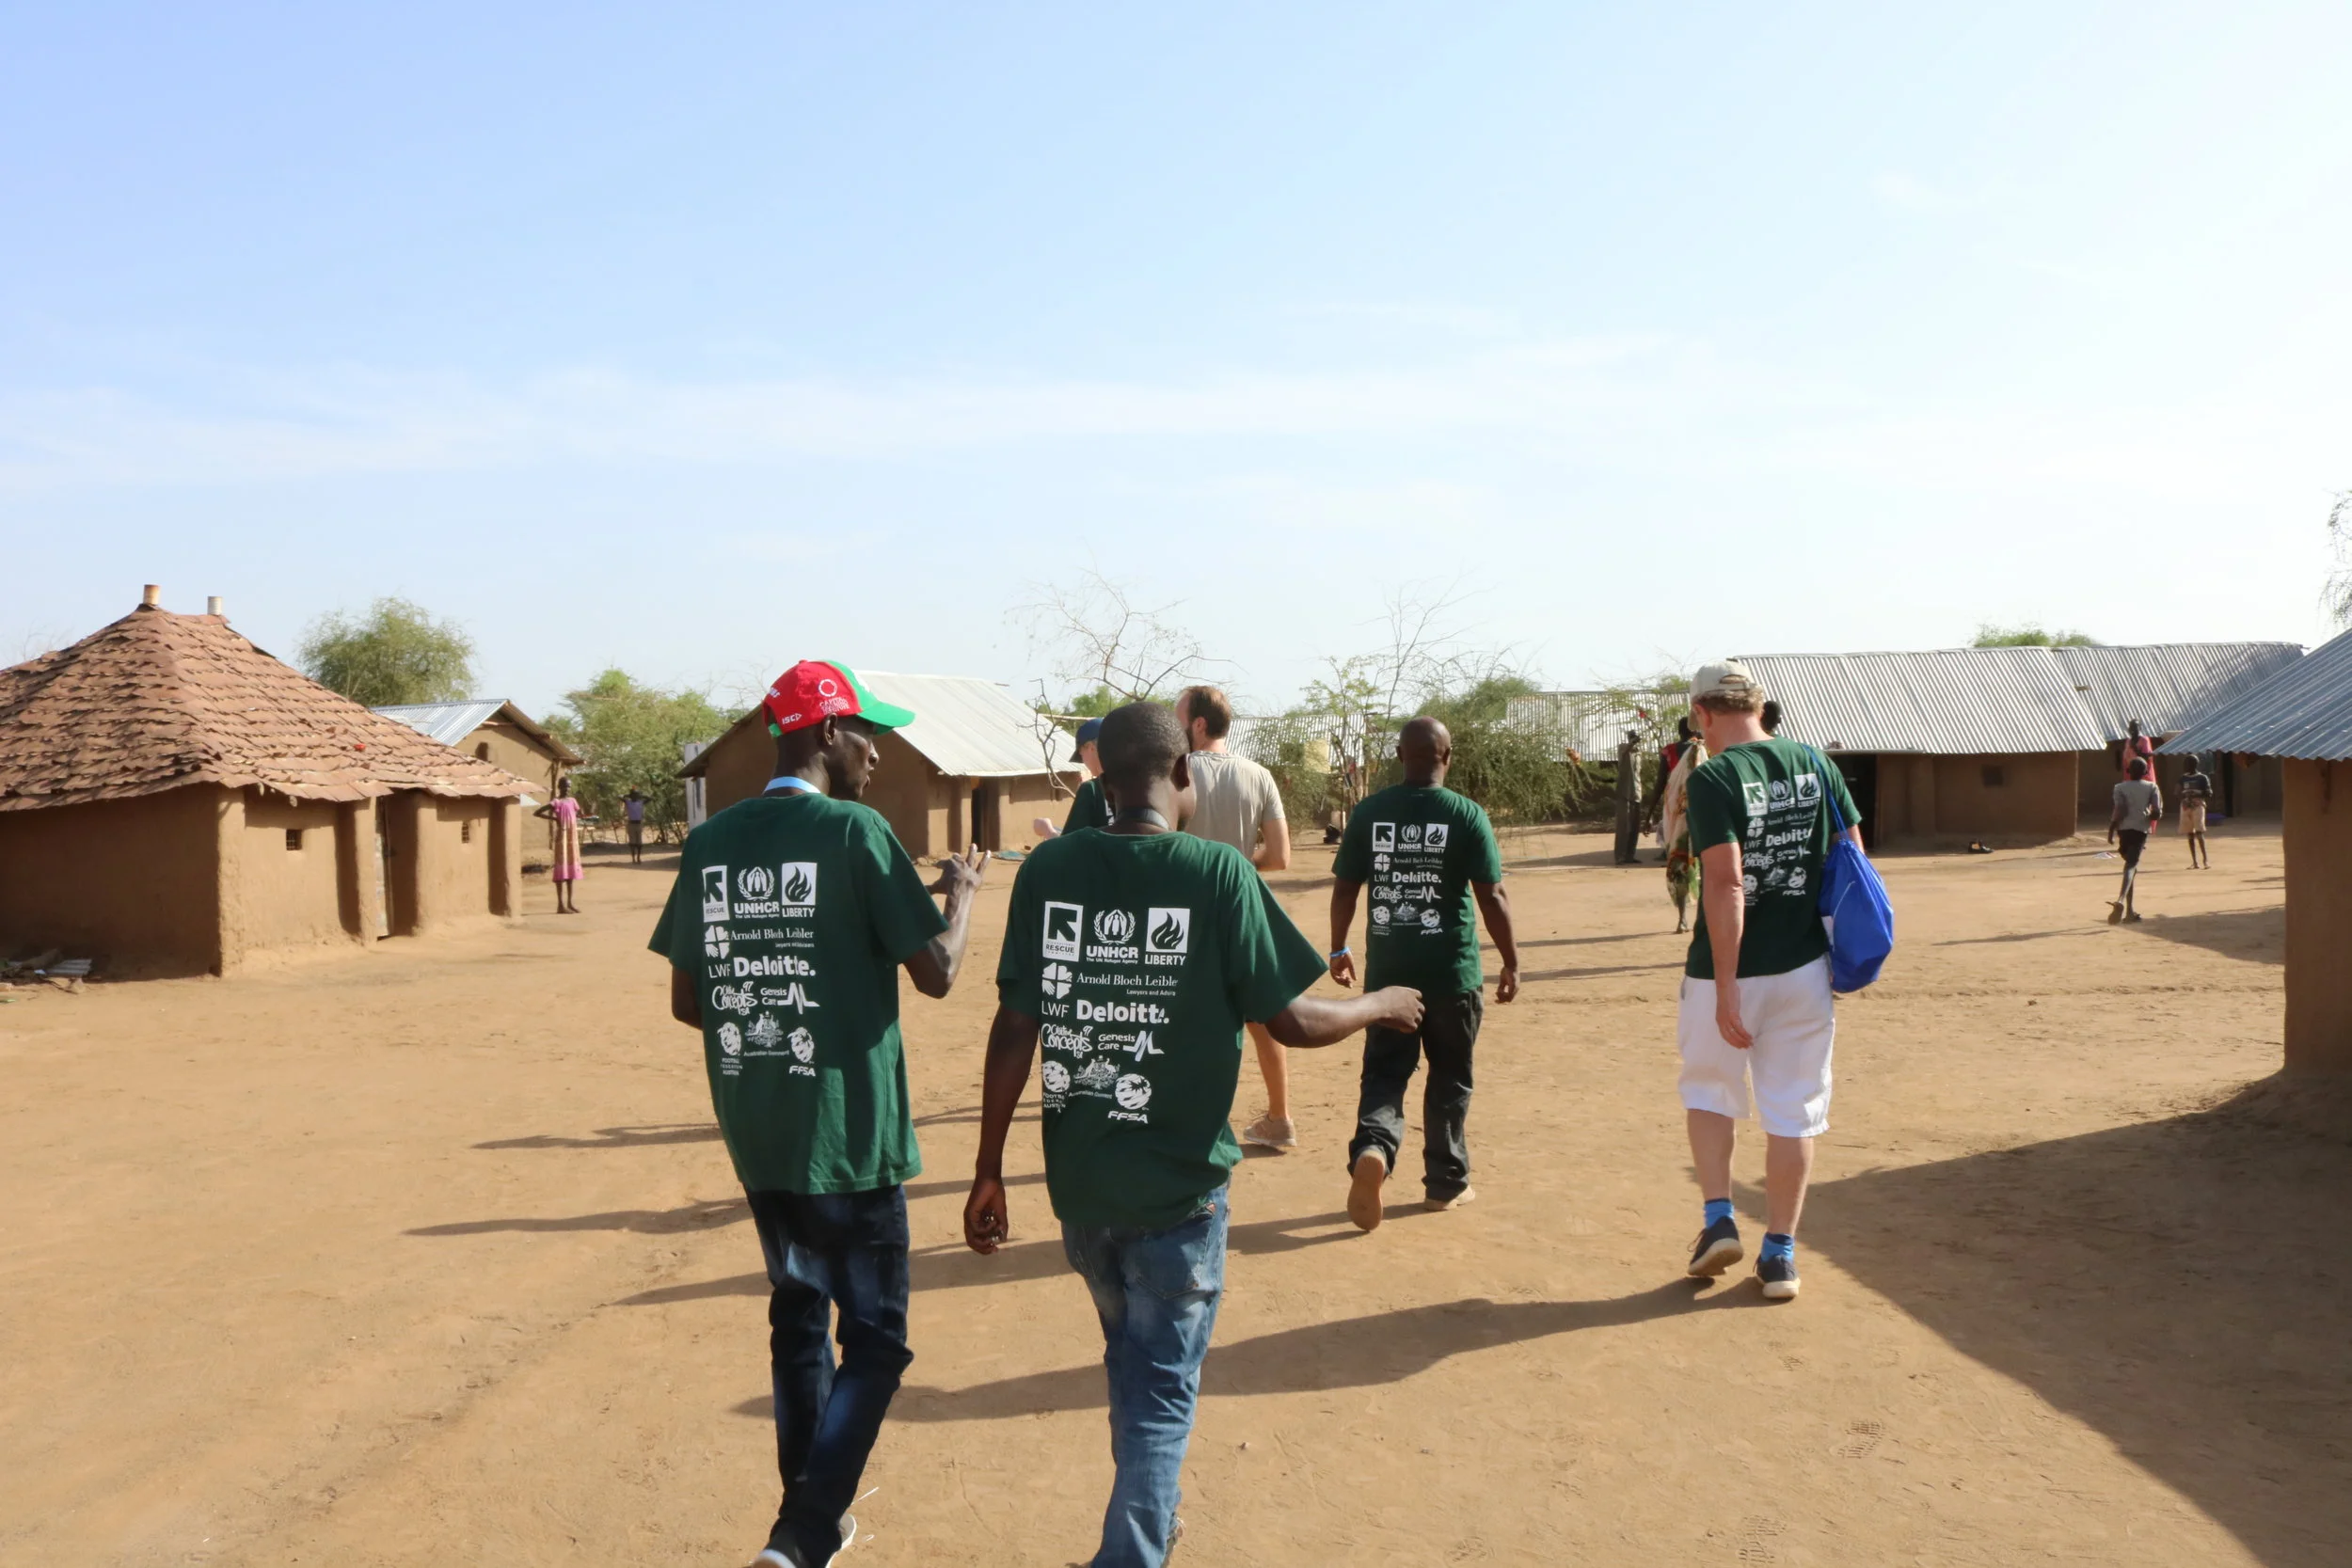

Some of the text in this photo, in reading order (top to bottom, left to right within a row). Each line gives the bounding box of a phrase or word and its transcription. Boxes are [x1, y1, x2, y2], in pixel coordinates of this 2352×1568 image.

[1375, 875, 1390, 883] LWF
[734, 901, 781, 914] UNHCR
[782, 907, 816, 918] LIBERTY
[731, 929, 762, 941] Arnold
[1045, 944, 1075, 954] RESCUE
[1086, 945, 1139, 958] UNHCR
[1144, 954, 1186, 966] LIBERTY
[708, 963, 731, 978] LWF
[1076, 973, 1111, 985] Arnold
[1113, 975, 1142, 986] Bloch
[1041, 1000, 1070, 1018] LWF
[1098, 1034, 1136, 1043] Genesis
[1097, 1042, 1120, 1051] Care
[788, 1065, 816, 1076] FFSA
[1107, 1110, 1149, 1124] FFSA
